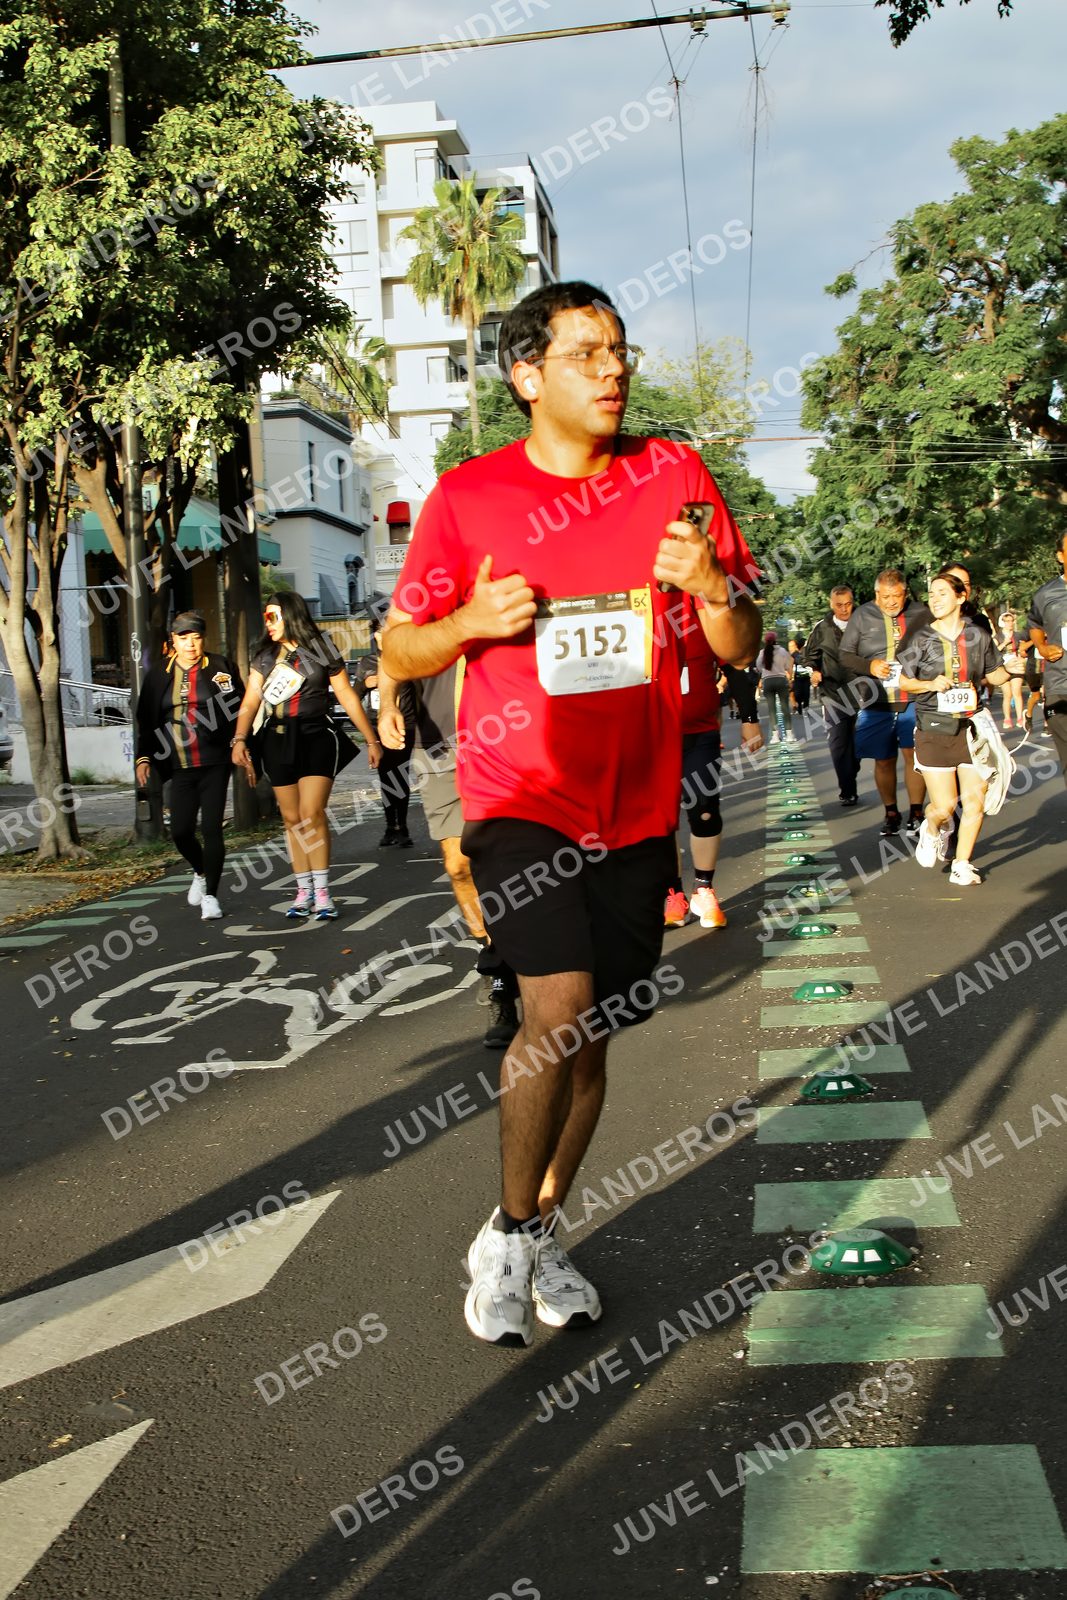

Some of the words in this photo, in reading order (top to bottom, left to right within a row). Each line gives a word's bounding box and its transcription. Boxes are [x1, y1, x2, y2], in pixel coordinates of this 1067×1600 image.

[555, 624, 628, 660] 5152
[270, 676, 290, 698] 1222
[943, 692, 969, 704] 4399
